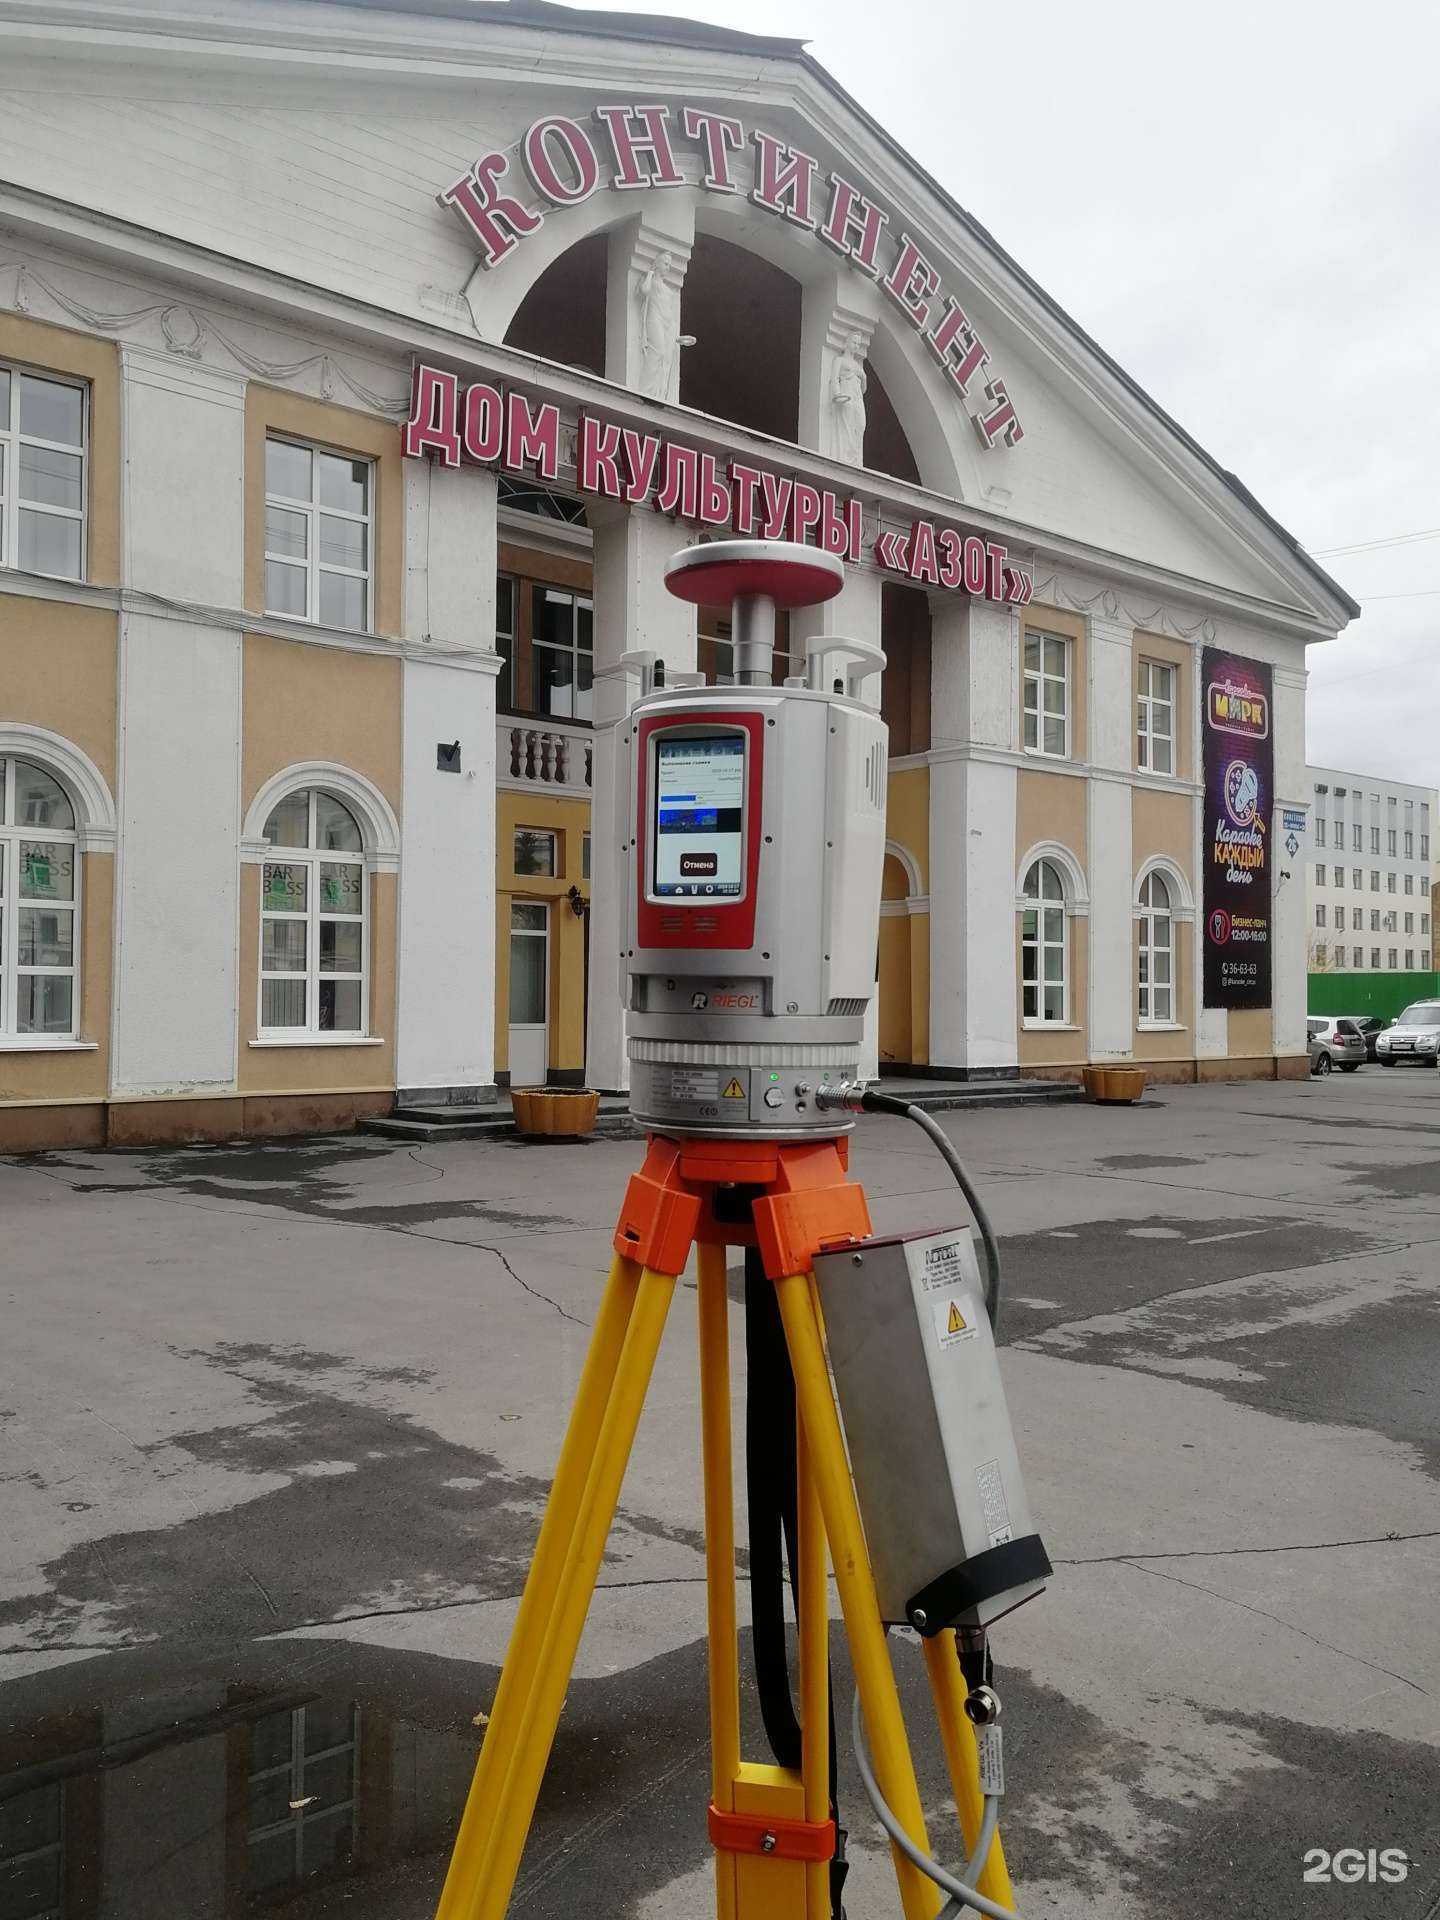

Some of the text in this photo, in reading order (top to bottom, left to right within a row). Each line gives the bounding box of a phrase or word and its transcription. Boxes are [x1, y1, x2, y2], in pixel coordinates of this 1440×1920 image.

[438, 105, 1025, 450] КОНТИНЕНТ
[402, 364, 1034, 606] ДОМ КУЛЬТУРЫ «АЗОТ»
[263, 864, 293, 881] BAR
[683, 861, 714, 869] Отмена
[263, 879, 305, 896] BSS
[1229, 962, 1257, 975] 36-63-63
[712, 994, 758, 1008] RIEGL
